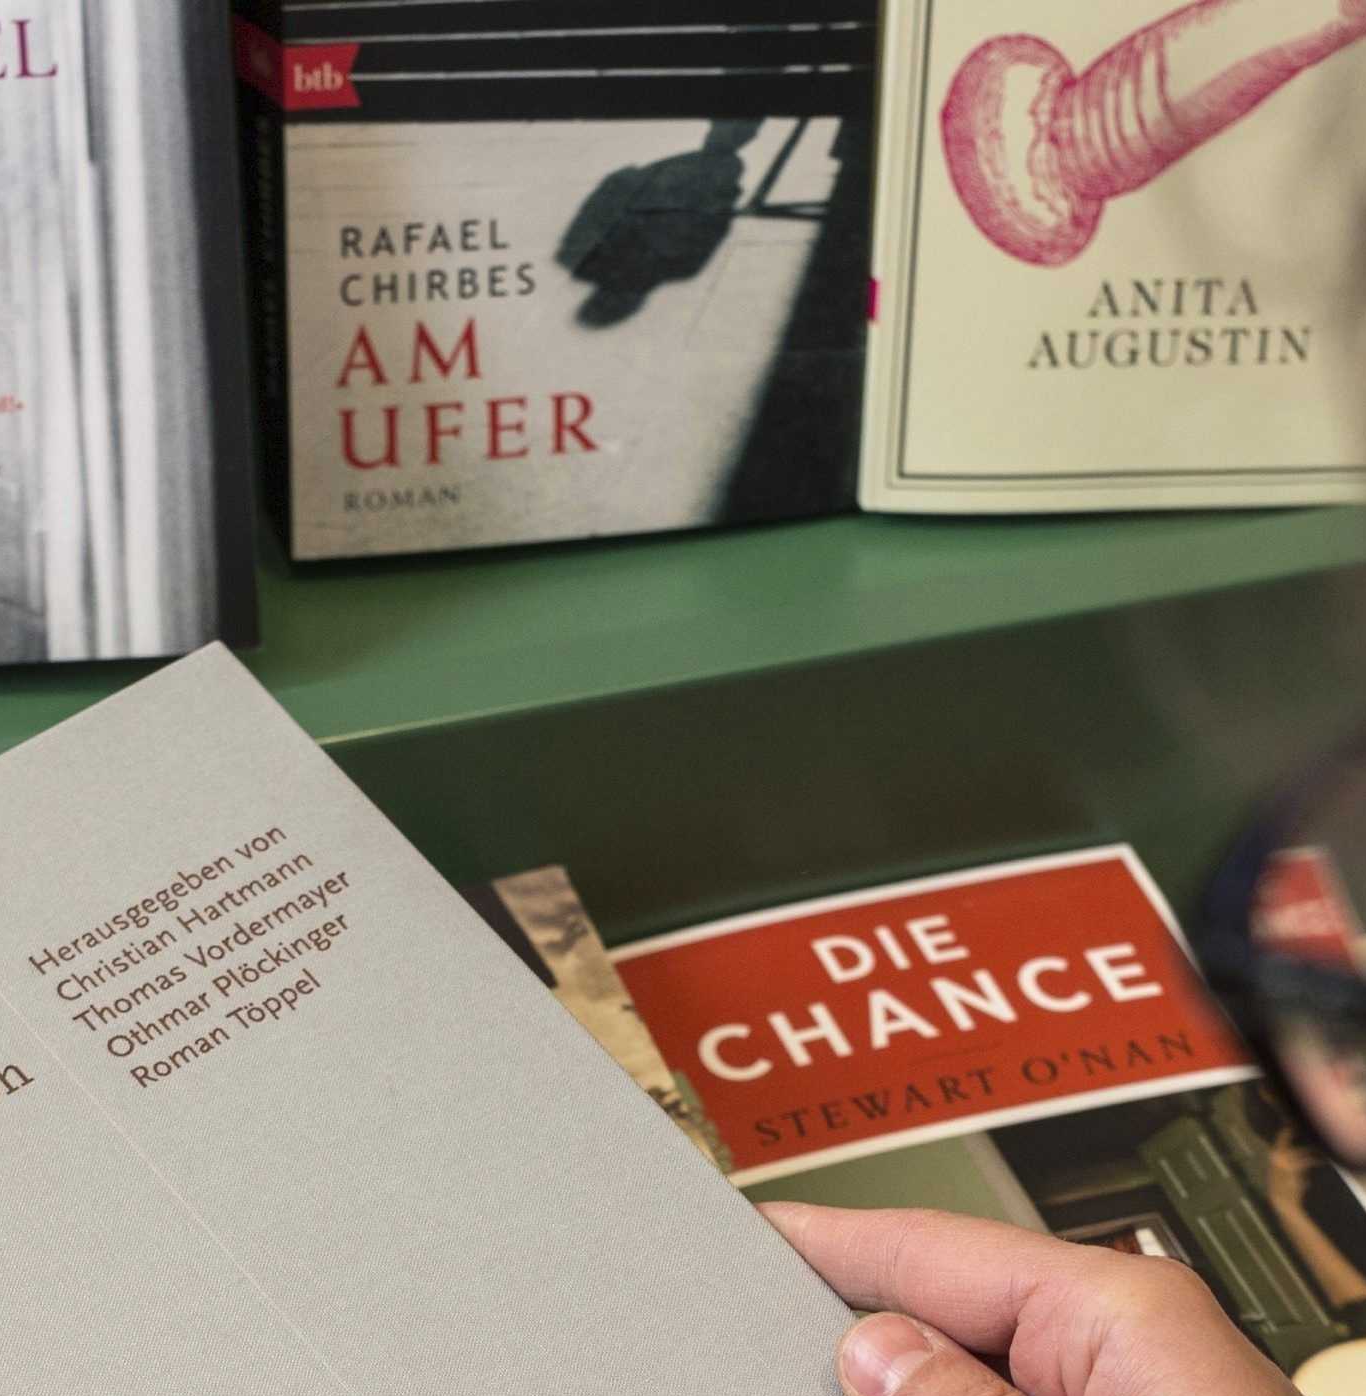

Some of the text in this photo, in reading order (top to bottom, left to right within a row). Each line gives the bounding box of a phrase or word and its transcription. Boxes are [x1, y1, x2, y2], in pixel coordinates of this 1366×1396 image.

[293, 62, 345, 92] btb
[340, 220, 509, 259] RAFAEL
[340, 262, 537, 307] CHIRBES
[1087, 278, 1260, 318] ANITA
[337, 318, 483, 390] AM
[1027, 326, 1313, 369] AUGUSTIN
[340, 391, 600, 471] UFER
[343, 484, 462, 514] ROMAN
[29, 826, 288, 975] Herausgegeben von
[56, 852, 314, 1001] Christian Hartmann
[72, 871, 351, 1032] Thomas Vordermayer
[106, 914, 351, 1057] Othmar Plöckinger
[811, 913, 970, 984] DIE
[130, 968, 322, 1089] Roman Töppel
[698, 942, 1164, 1082] CHANCE
[754, 1029, 1198, 1147] STEWART O'NAN
